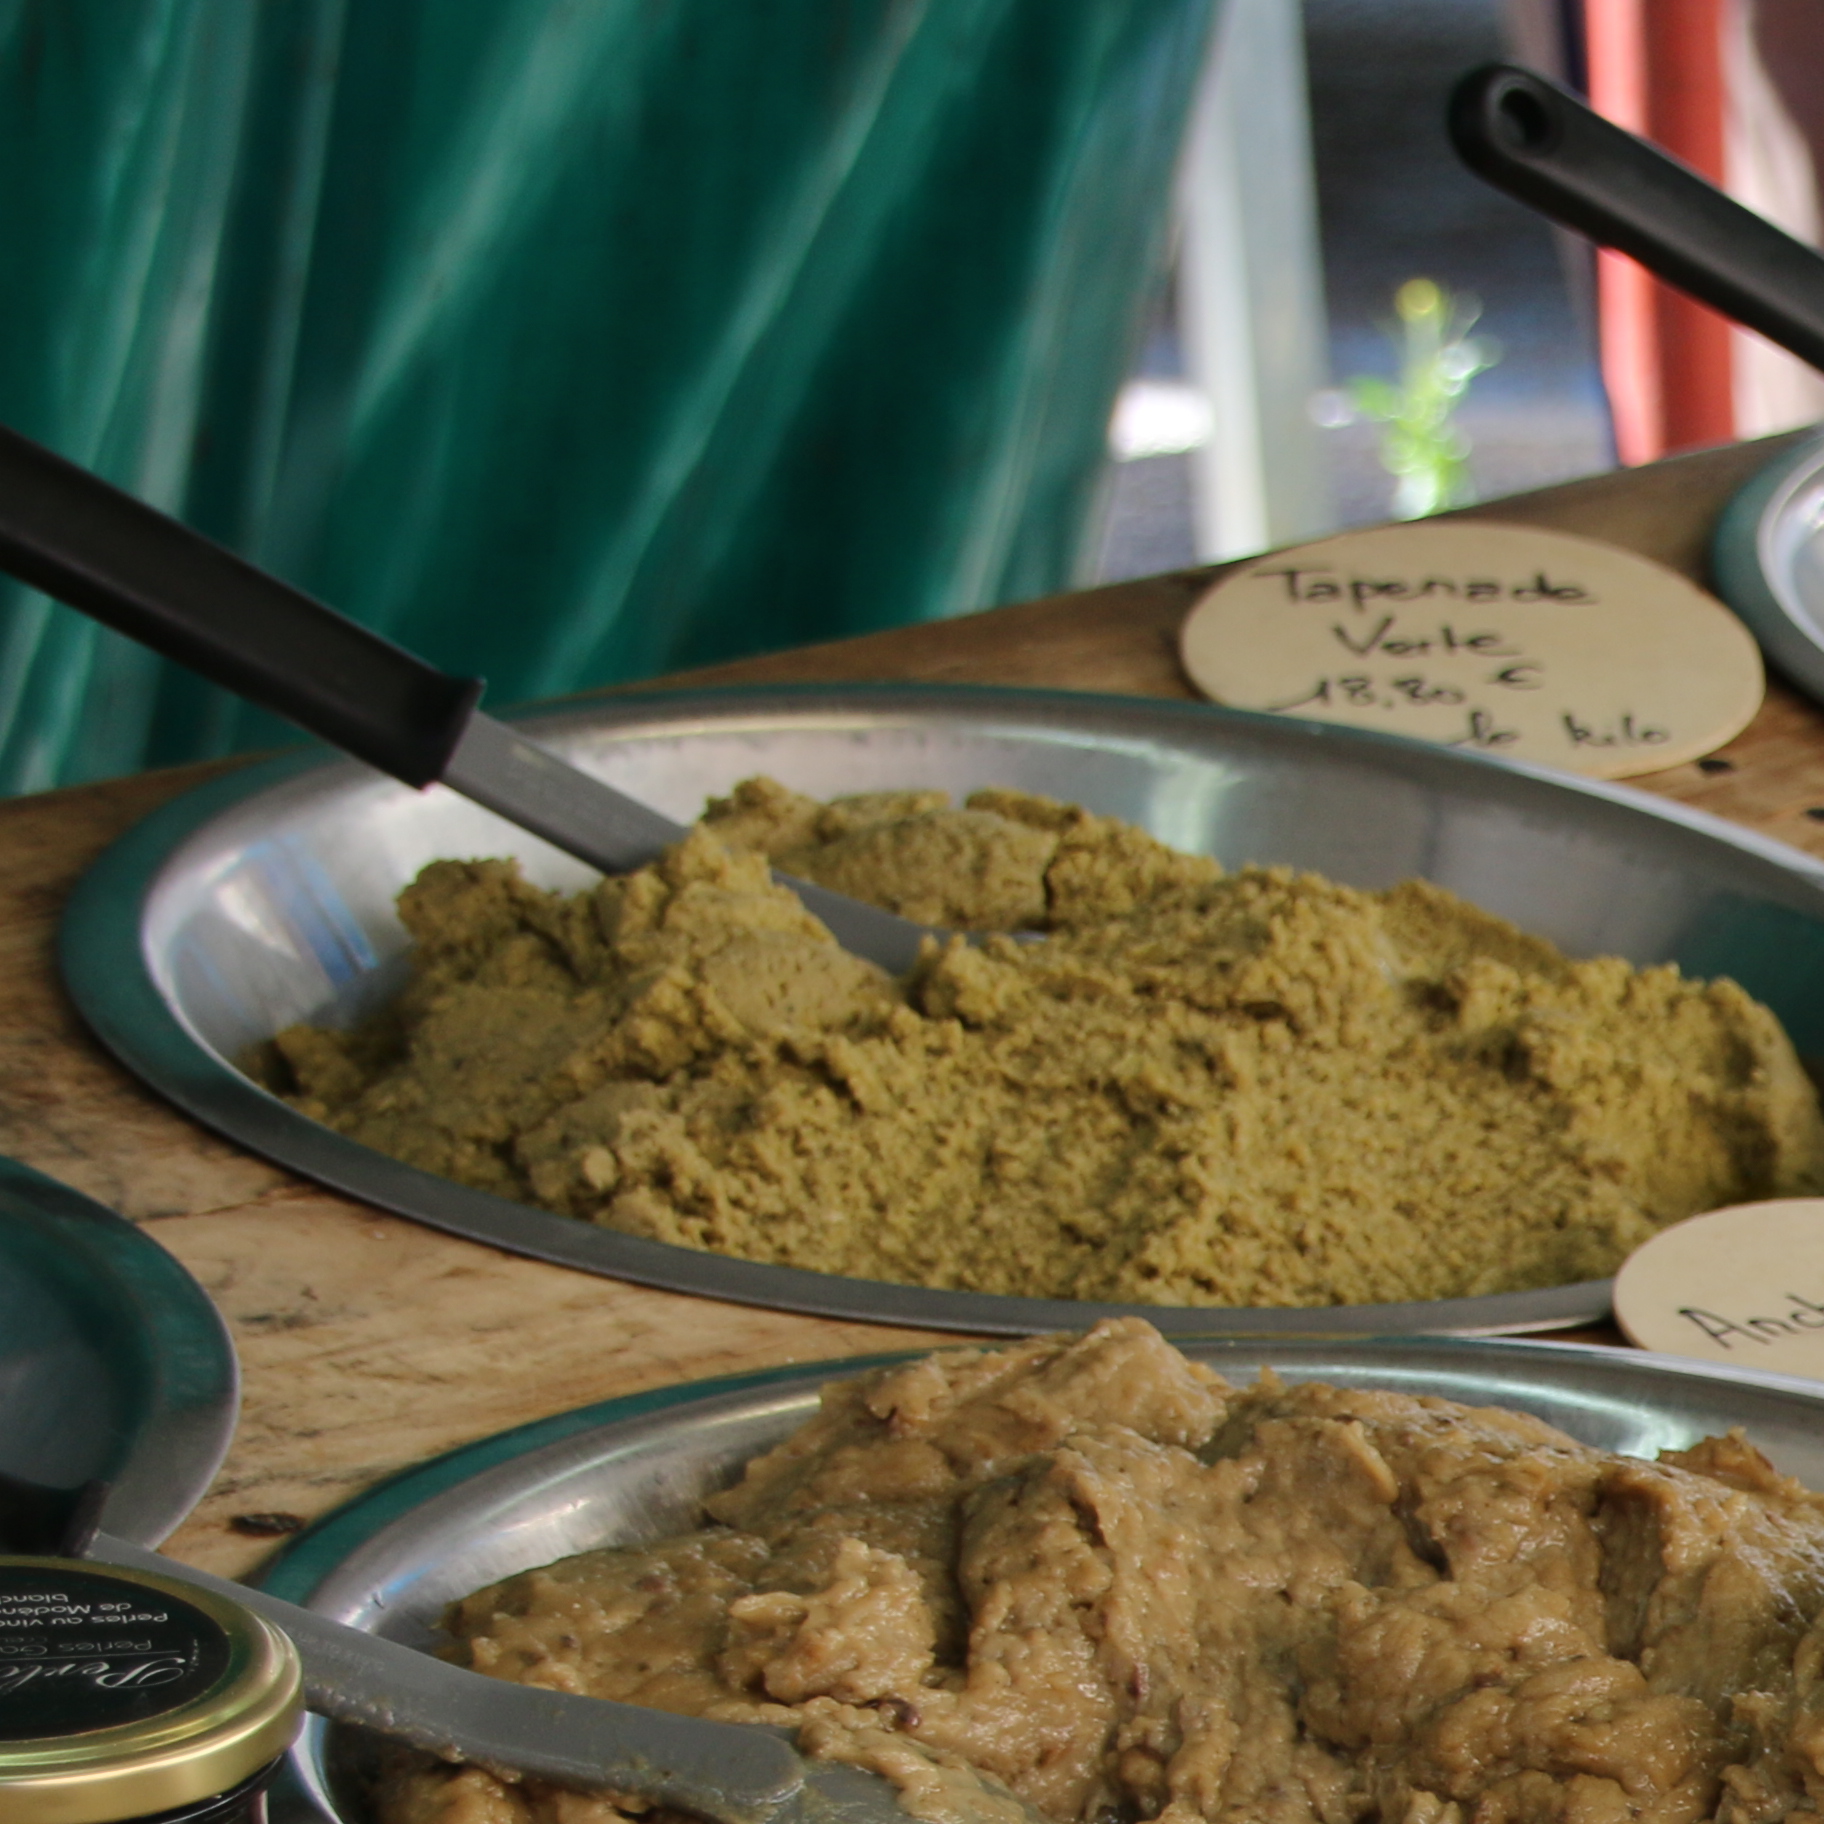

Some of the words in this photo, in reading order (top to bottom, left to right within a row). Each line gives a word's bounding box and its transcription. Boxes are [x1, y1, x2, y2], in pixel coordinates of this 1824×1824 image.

[1252, 569, 1600, 612] Tapenade
[1331, 614, 1522, 657] Verte
[0, 1592, 70, 1605] blanc
[0, 1603, 91, 1617] Modèn
[99, 1602, 133, 1613] de
[51, 1616, 84, 1626] au
[90, 1611, 169, 1625] Perles
[58, 1639, 152, 1654] Perles
